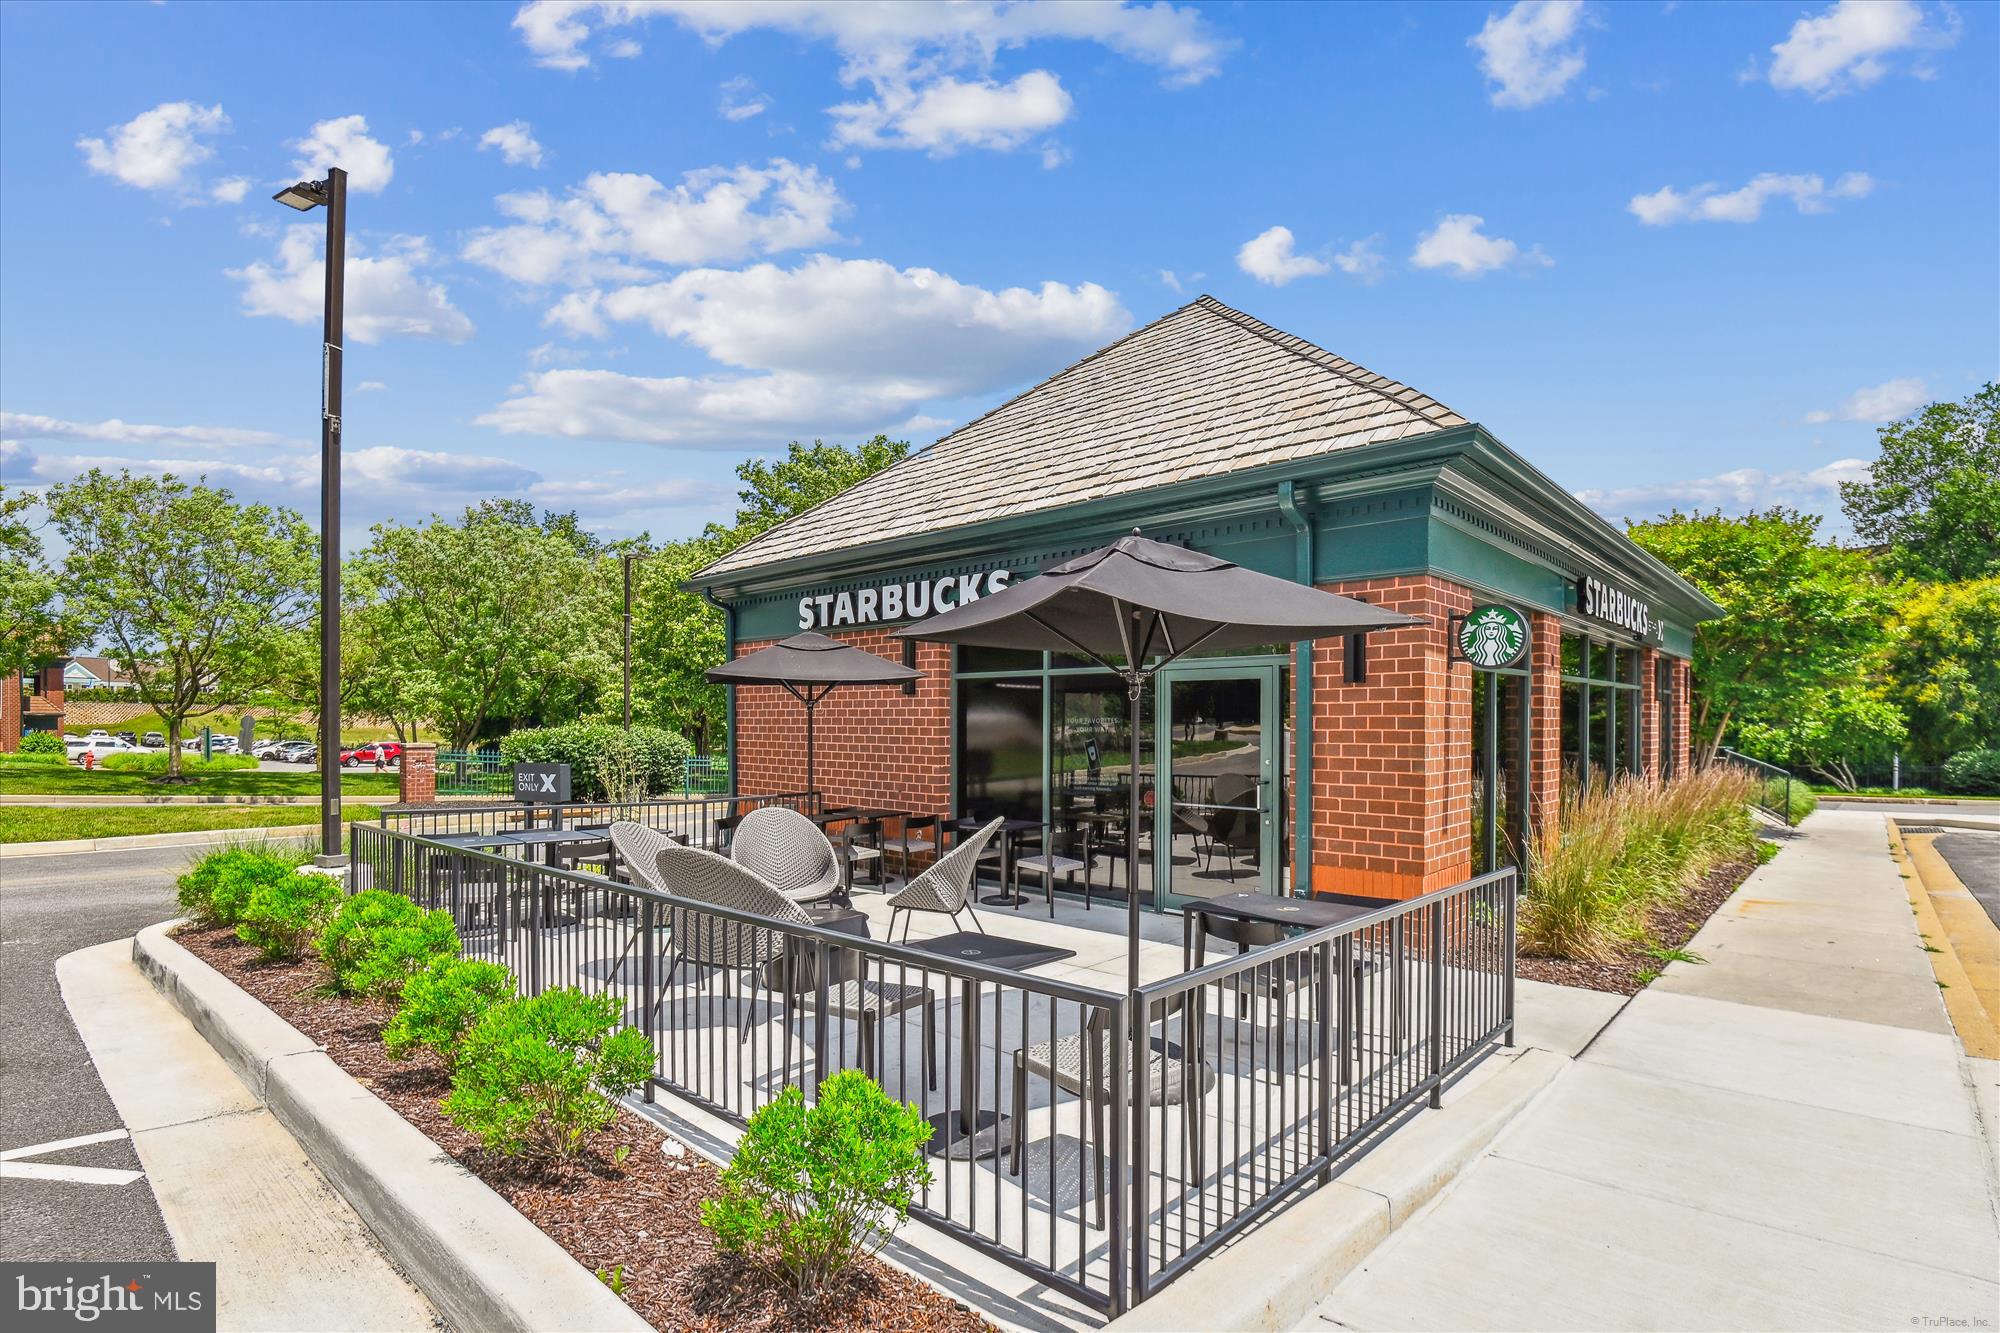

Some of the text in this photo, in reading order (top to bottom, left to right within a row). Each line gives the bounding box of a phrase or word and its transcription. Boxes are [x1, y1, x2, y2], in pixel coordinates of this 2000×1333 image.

[798, 569, 1010, 630] STARBUCKS
[1586, 576, 1648, 635] STARBUCKS
[518, 773, 535, 782] EXIT
[518, 782, 539, 791] ONLY
